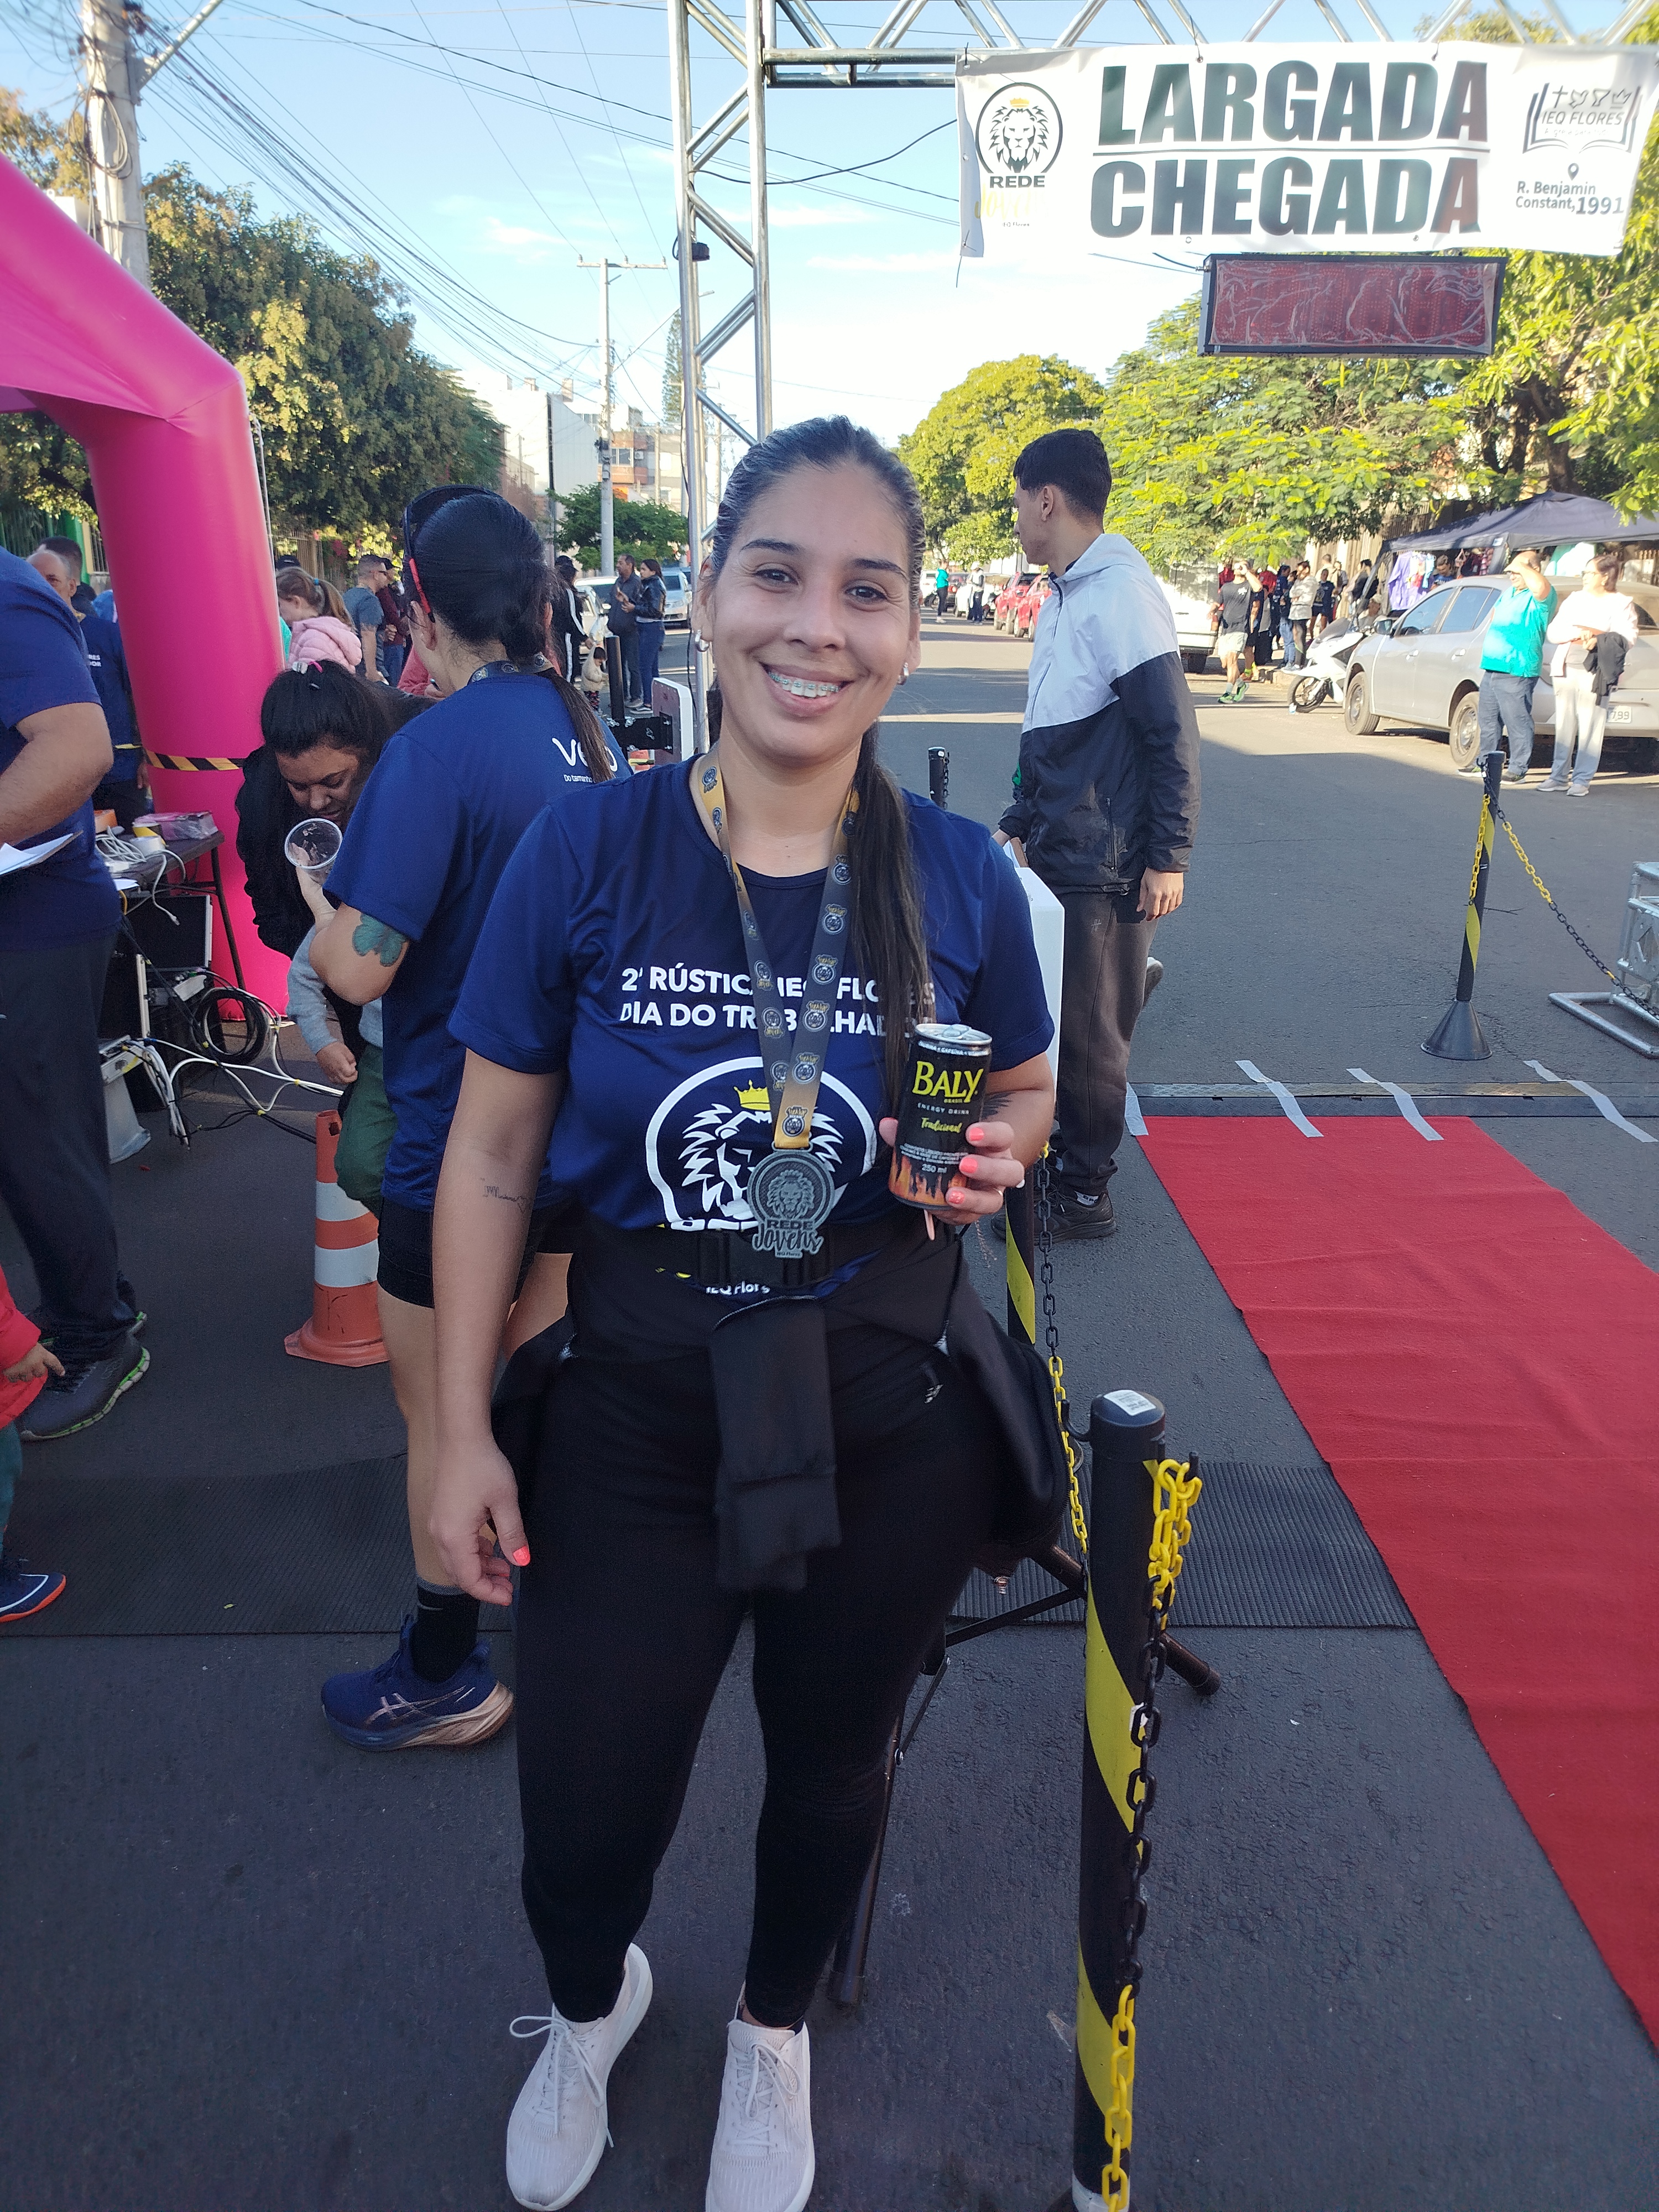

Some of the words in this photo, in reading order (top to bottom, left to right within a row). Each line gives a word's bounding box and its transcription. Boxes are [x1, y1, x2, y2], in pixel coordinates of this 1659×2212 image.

[1098, 60, 1488, 146] LARGADA
[1542, 111, 1566, 125] IEQ
[1569, 111, 1625, 125] FLORES
[989, 175, 1045, 189] REDE
[1517, 180, 1530, 194] R.
[1533, 181, 1596, 198] Benjamin
[1090, 156, 1481, 238] CHEGADA
[1576, 196, 1625, 215] 1991
[649, 962, 753, 995] RÚSTIC
[777, 977, 807, 997] IE
[670, 1003, 716, 1026] DO
[912, 1061, 984, 1103] BALY
[922, 1164, 936, 1173] 250
[766, 1219, 813, 1230] REDE
